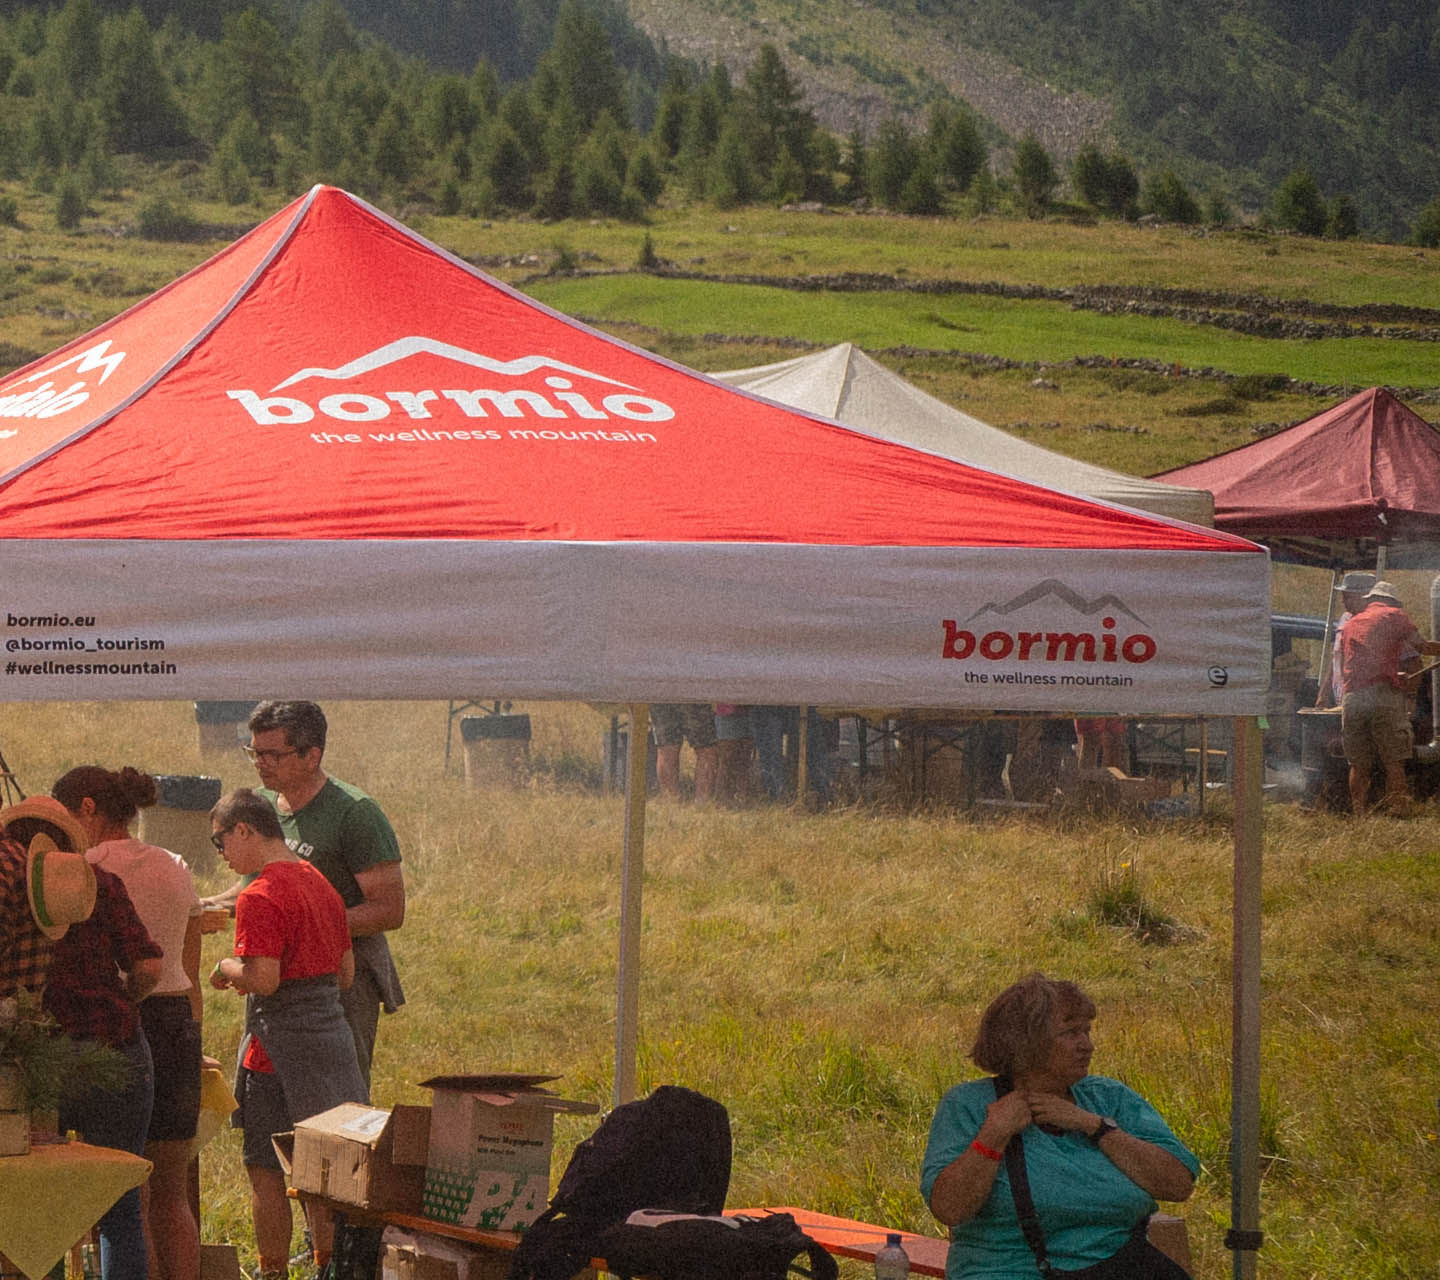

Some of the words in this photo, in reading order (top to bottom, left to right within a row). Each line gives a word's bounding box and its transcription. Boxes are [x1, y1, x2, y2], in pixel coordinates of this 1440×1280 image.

[226, 376, 676, 425] bormio
[310, 431, 362, 444] the
[368, 427, 501, 443] wellness
[509, 427, 657, 443] mountain
[7, 613, 96, 627] bormio.eu
[5, 637, 165, 653] @bormio_tourism
[942, 616, 1157, 664] bormio
[5, 660, 177, 675] #wellnessmountain
[964, 671, 989, 684] the
[992, 671, 1057, 685] wellness
[1060, 673, 1134, 687] mountain
